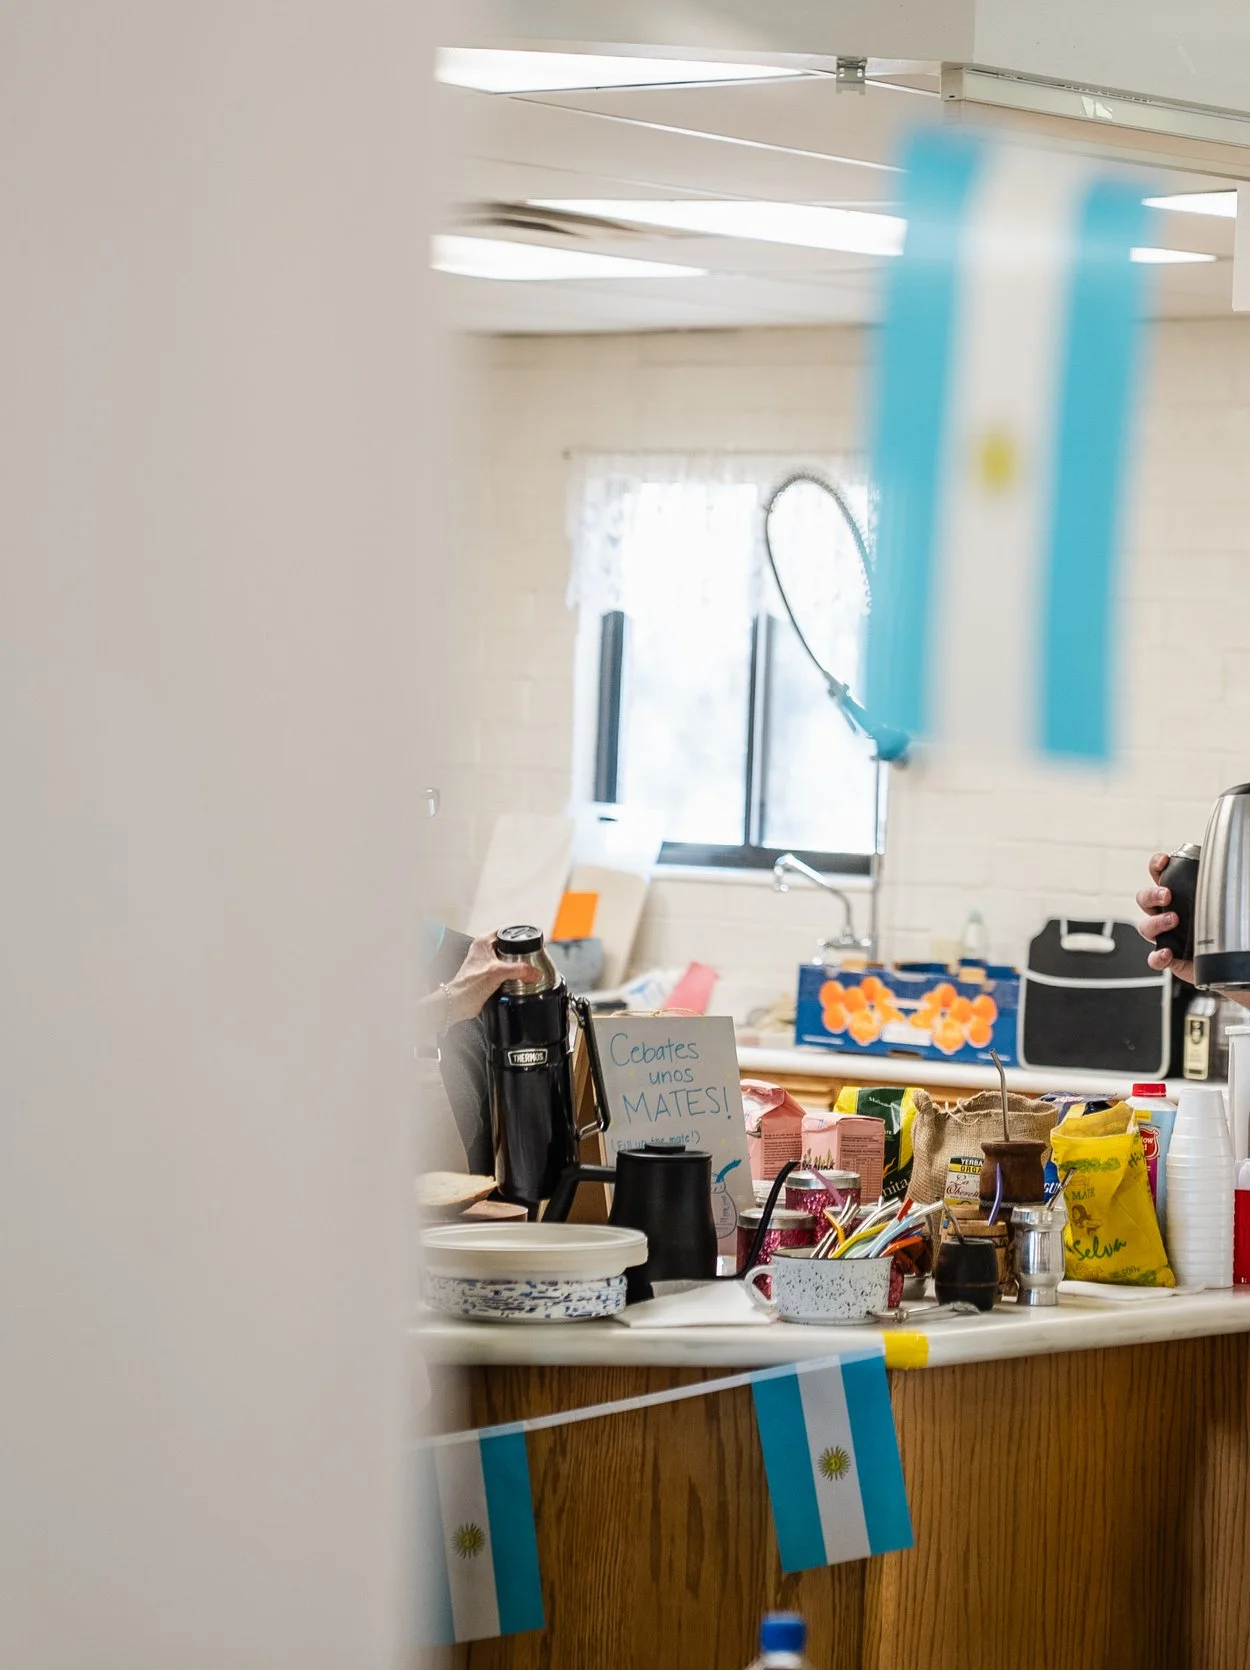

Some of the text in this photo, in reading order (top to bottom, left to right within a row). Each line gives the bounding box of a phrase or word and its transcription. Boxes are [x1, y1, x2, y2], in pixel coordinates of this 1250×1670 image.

[512, 1051, 544, 1063] THERMOS
[610, 1032, 699, 1066] Cebates
[648, 1068, 694, 1084] unos
[622, 1086, 732, 1124] MATES!
[669, 1130, 701, 1145] mate!)
[960, 1158, 983, 1167] YERBA
[1073, 1235, 1127, 1261] Selva
